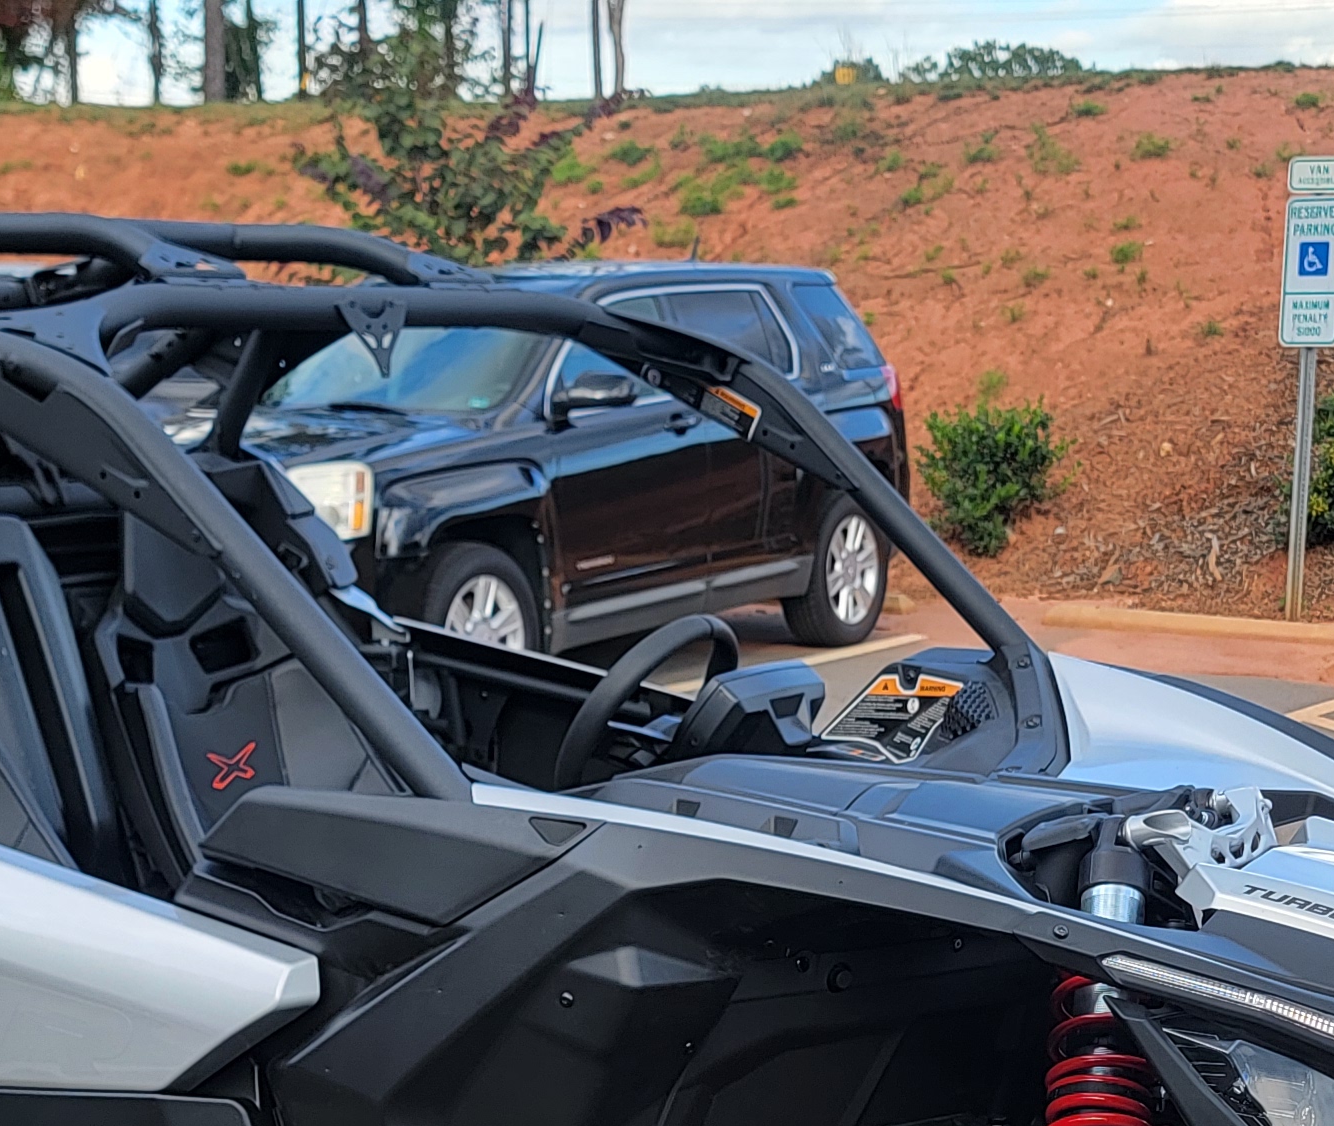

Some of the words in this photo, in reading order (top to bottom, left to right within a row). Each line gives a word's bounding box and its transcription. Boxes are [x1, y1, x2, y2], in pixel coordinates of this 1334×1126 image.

[1309, 165, 1329, 175] VAN
[1292, 300, 1329, 310] MAXIMUM
[1292, 313, 1328, 323] PENALTY
